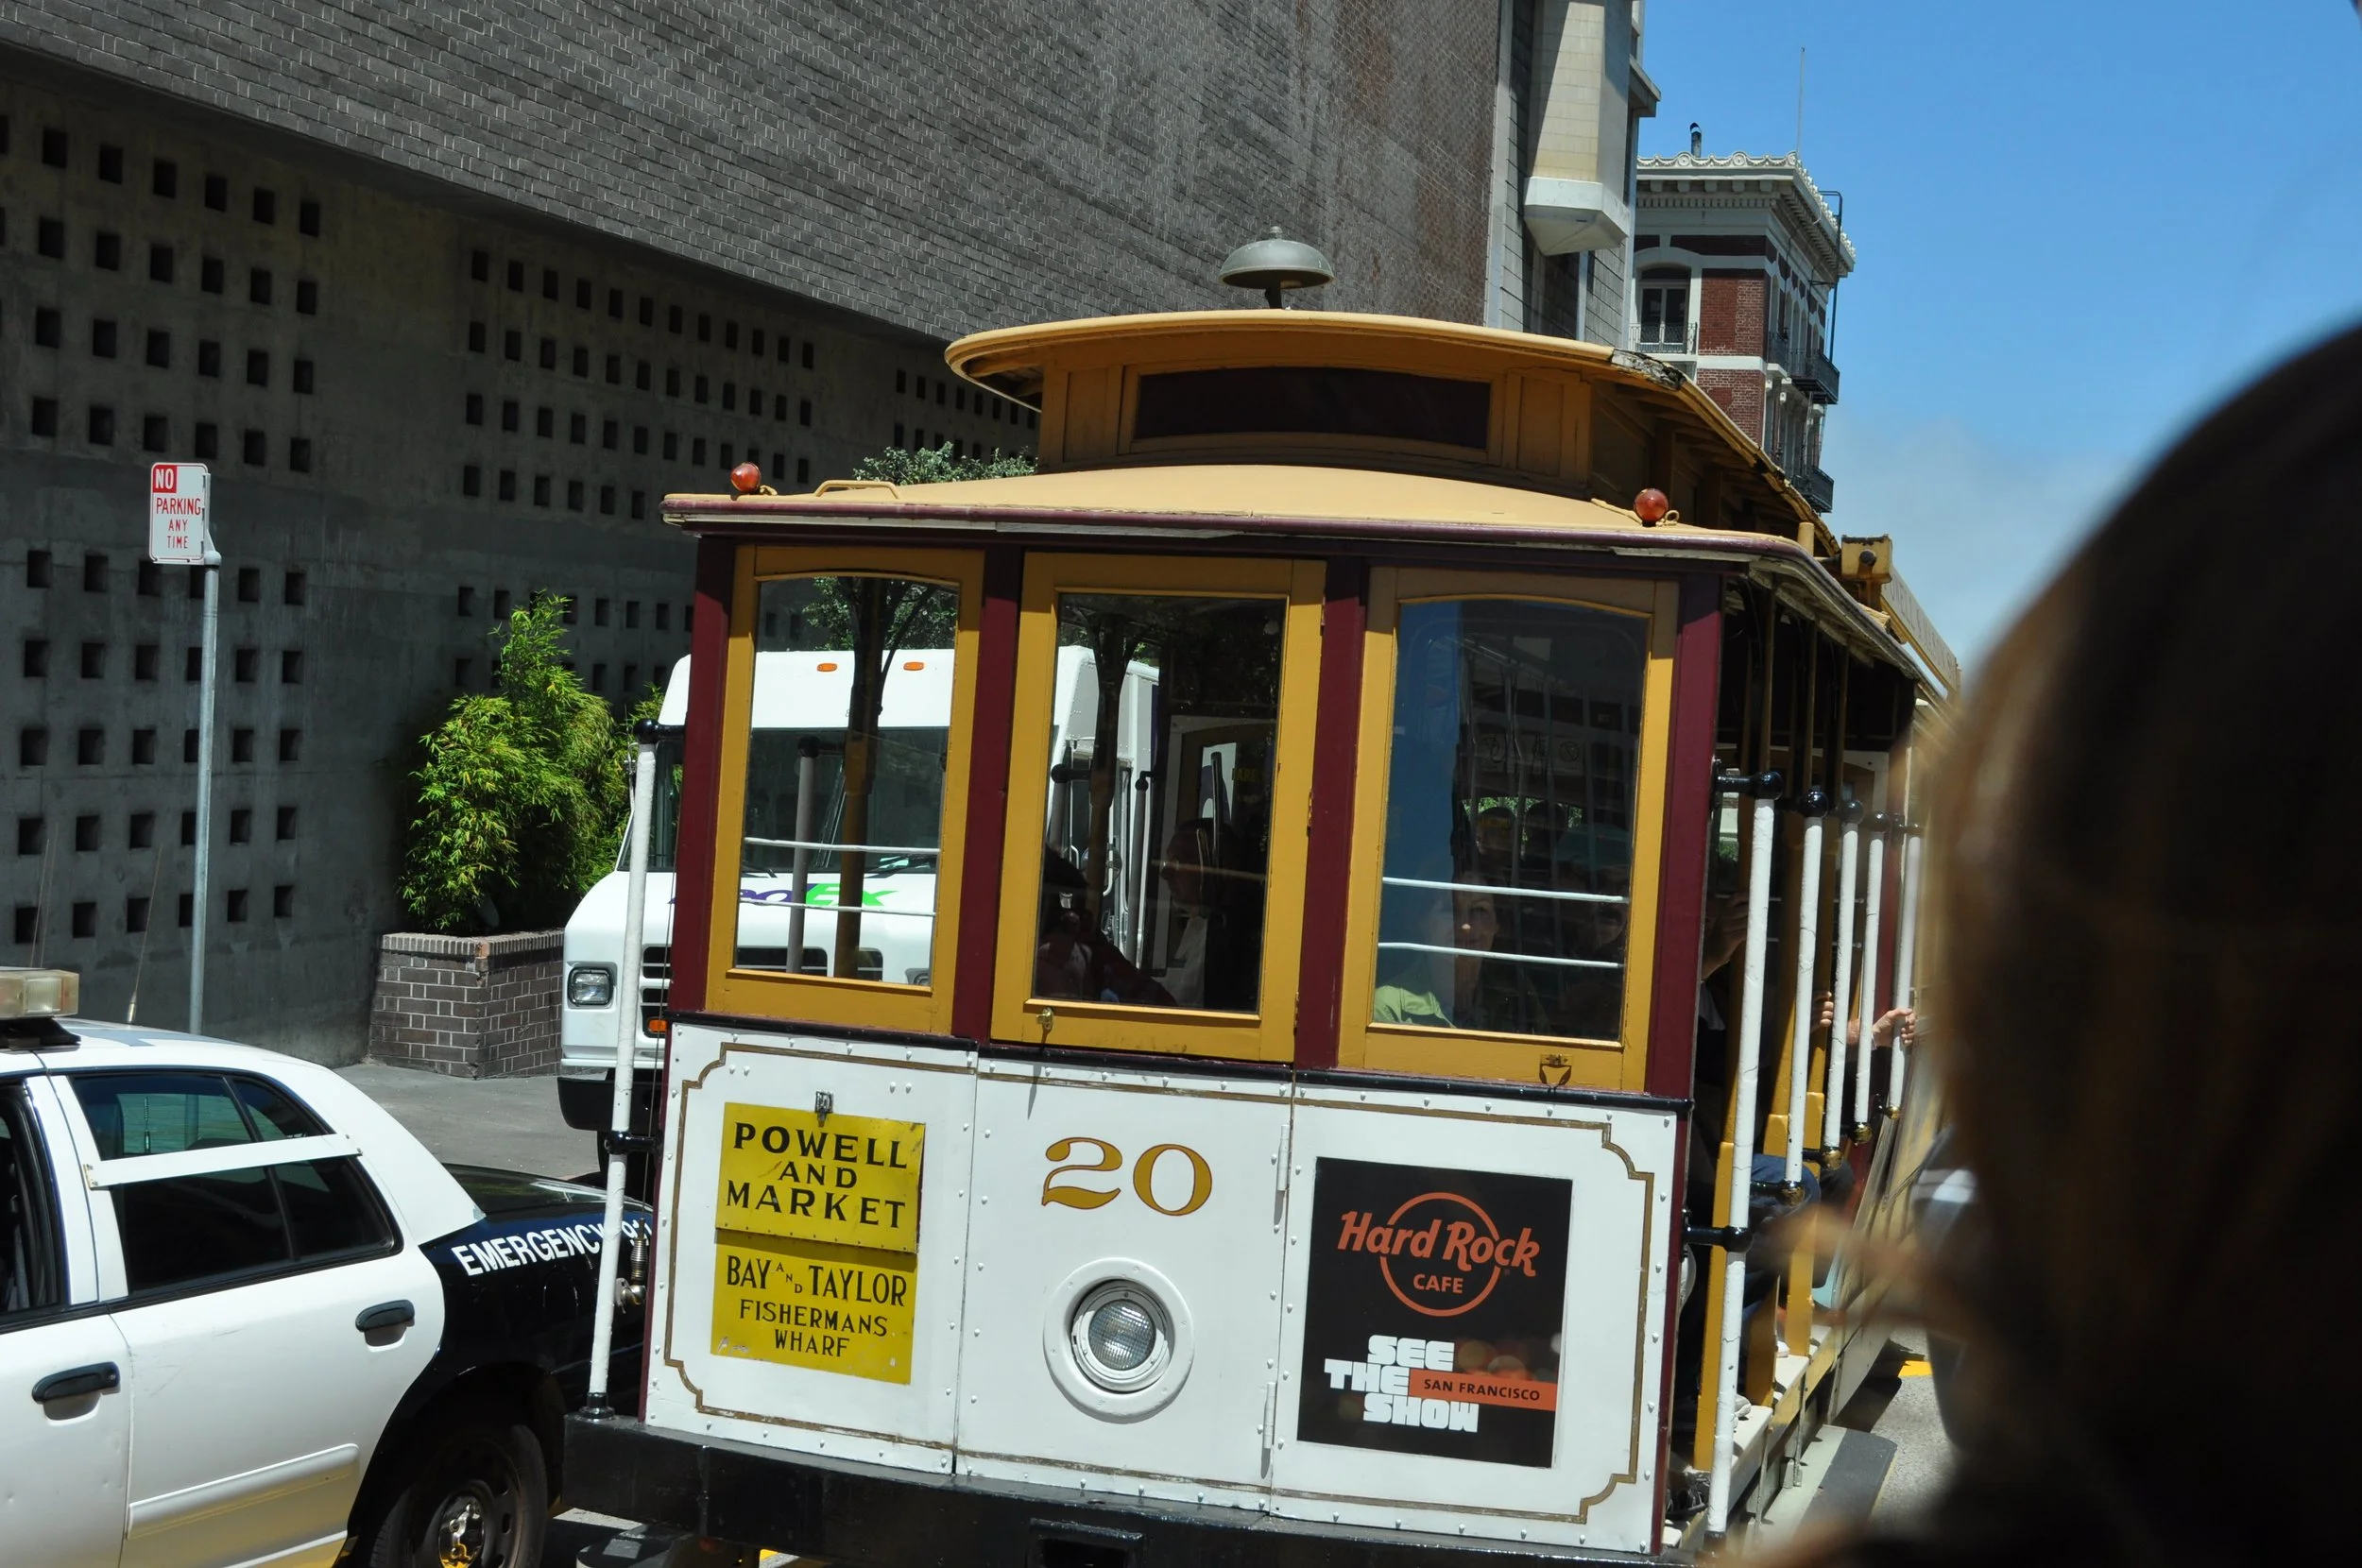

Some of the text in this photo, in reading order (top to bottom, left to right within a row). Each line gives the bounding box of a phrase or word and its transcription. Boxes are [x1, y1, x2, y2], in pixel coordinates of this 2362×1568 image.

[155, 468, 175, 489] NO
[156, 497, 201, 515] PARKING
[168, 519, 188, 531] ANY
[167, 536, 189, 548] TIME
[732, 1121, 908, 1169] POWELL
[778, 1161, 857, 1189] AND
[1041, 1136, 1213, 1217] 20
[727, 1180, 906, 1228] MARKET
[1337, 1210, 1541, 1277] Hard Rock
[727, 1254, 907, 1307] BAY AND TAYLOR
[1412, 1273, 1463, 1294] CAFE
[740, 1299, 888, 1338] FISHERMANS
[774, 1328, 850, 1357] WHARF
[1367, 1334, 1455, 1372] SEE
[1324, 1357, 1410, 1397] THE
[1424, 1378, 1541, 1402] SAN FRANCISCO
[1362, 1392, 1480, 1434] SHOW
